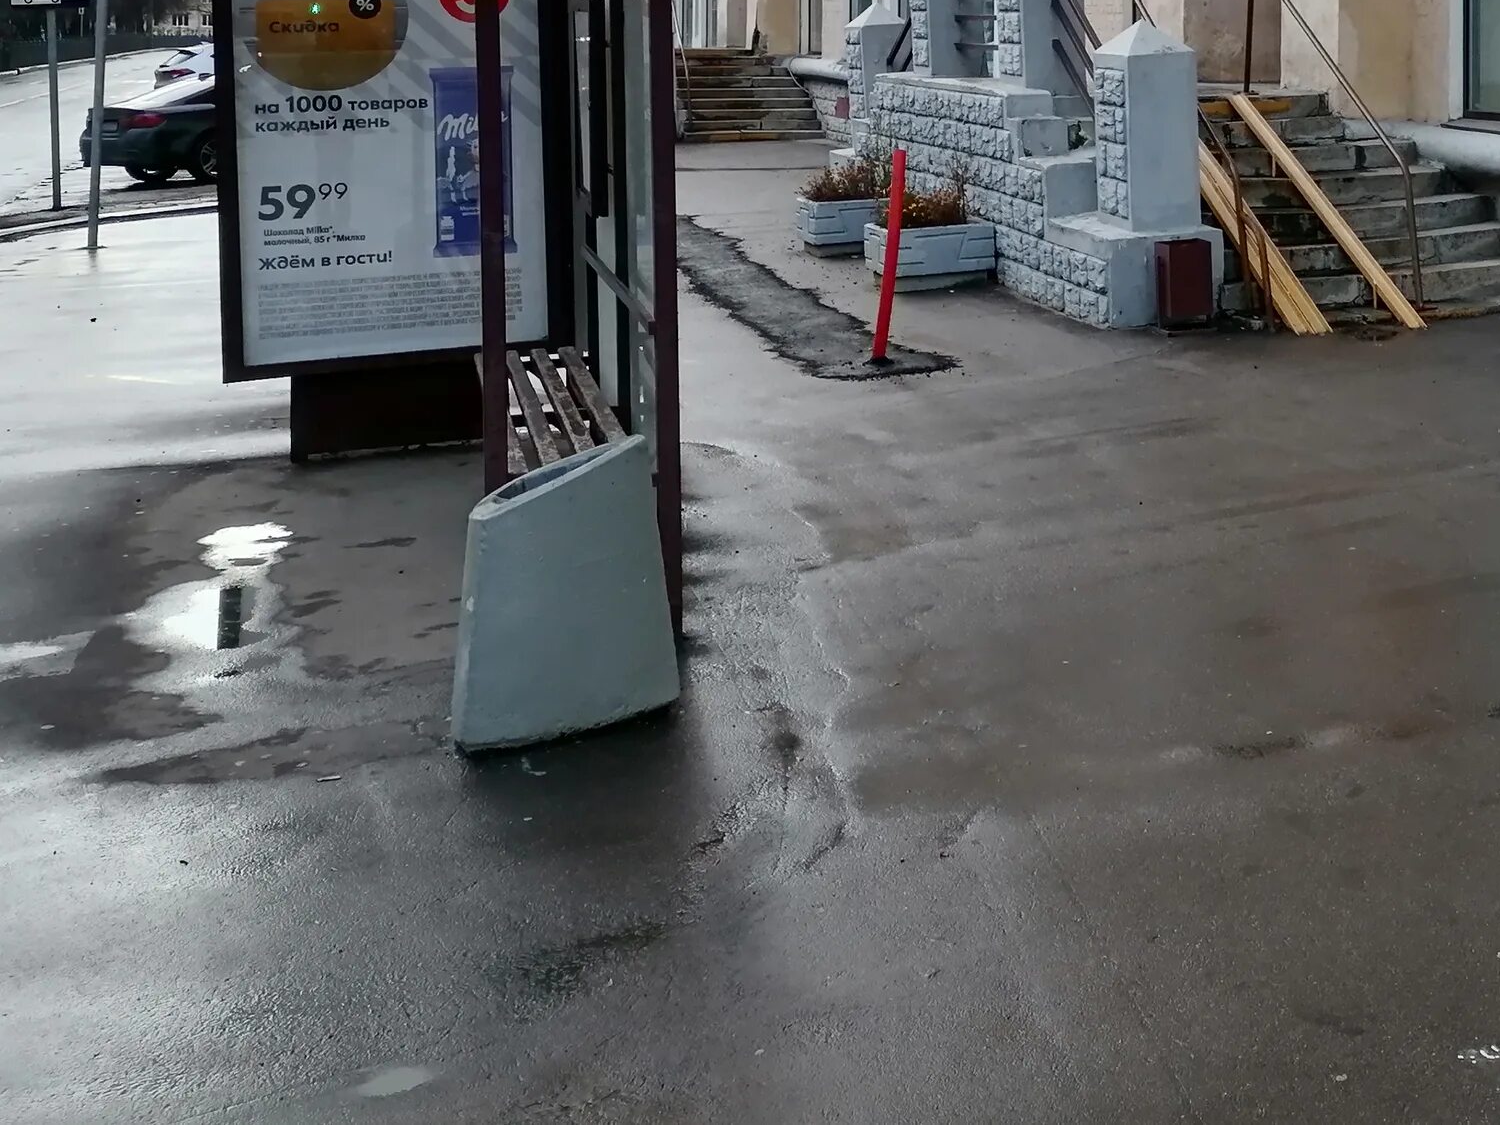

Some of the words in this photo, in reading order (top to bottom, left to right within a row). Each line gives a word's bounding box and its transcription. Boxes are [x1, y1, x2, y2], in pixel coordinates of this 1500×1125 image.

[269, 20, 340, 34] Скидка
[255, 103, 279, 115] на
[285, 95, 343, 113] 1000
[347, 98, 428, 113] товаров
[255, 116, 337, 133] каждый
[342, 116, 390, 132] день
[258, 184, 316, 221] 59
[263, 228, 304, 238] Шоколад
[258, 255, 315, 271] Ждём
[321, 256, 331, 267] в
[336, 250, 393, 266] гости!
